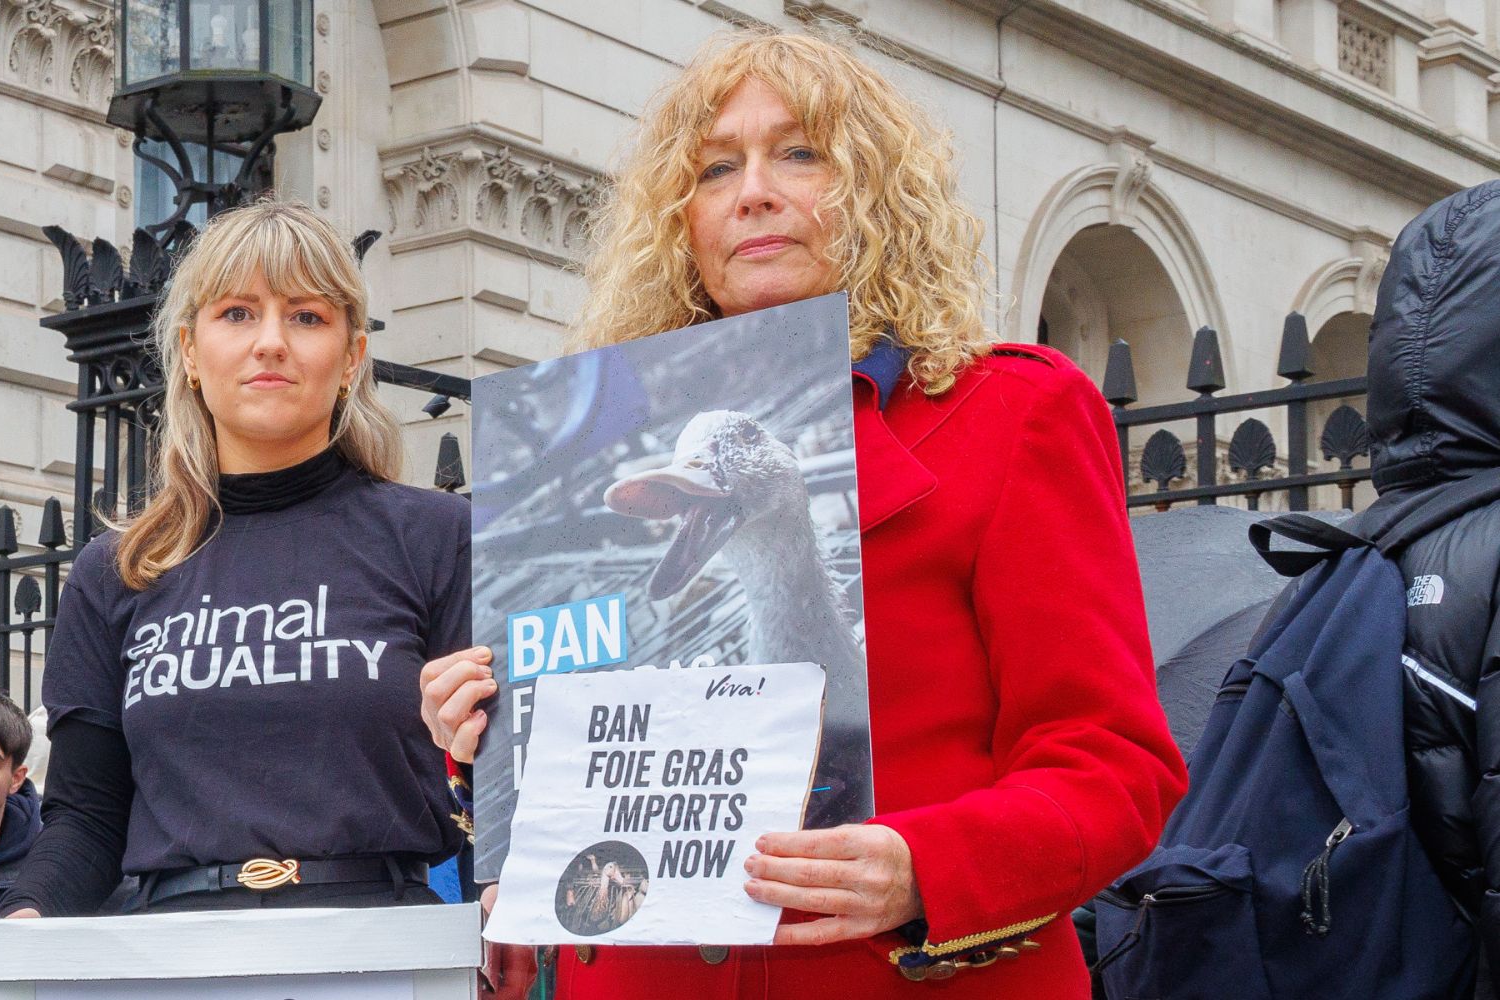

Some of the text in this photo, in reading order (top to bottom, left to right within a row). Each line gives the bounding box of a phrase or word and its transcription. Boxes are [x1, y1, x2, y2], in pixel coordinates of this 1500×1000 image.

[1413, 575, 1431, 586] THE
[126, 584, 328, 660] animal
[512, 598, 621, 678] BAN
[125, 639, 388, 710] EQUALITY
[705, 674, 766, 700] Viva!
[587, 703, 651, 743] BAN
[585, 748, 749, 788] FOIE GRAS
[603, 793, 748, 833] IMPORTS
[656, 839, 736, 879] NOW
